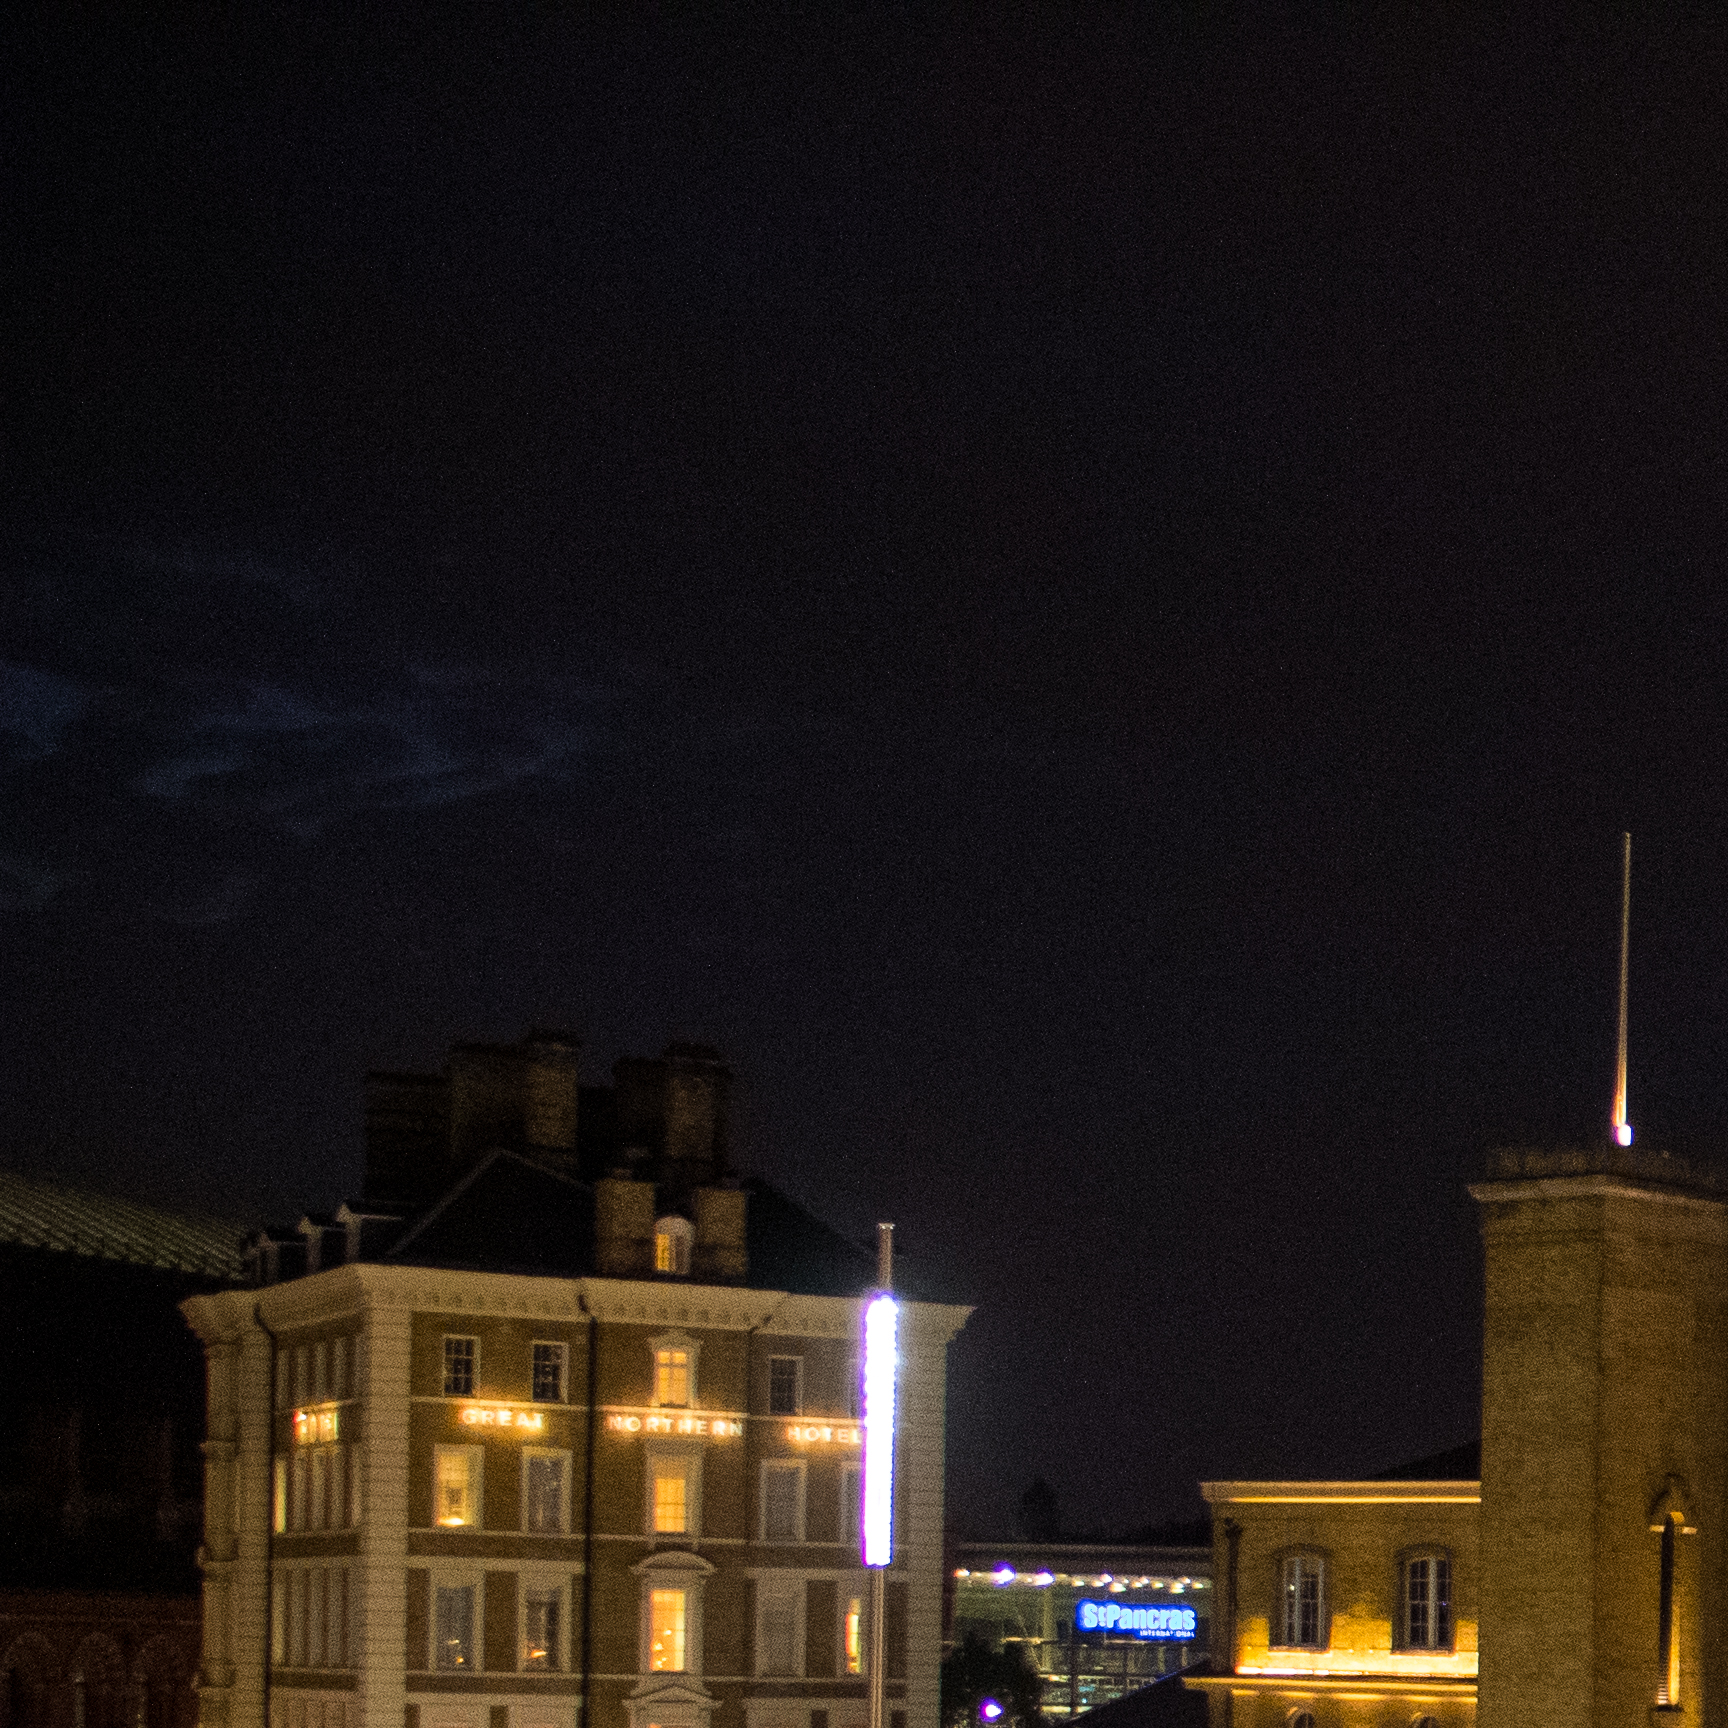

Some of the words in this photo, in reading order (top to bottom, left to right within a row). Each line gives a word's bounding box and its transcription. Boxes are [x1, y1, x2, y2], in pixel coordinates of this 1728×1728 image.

[461, 1408, 544, 1428] GREAT
[609, 1415, 743, 1437] NORTHERN
[787, 1425, 862, 1444] HOTEL
[1106, 1604, 1195, 1631] Pancras
